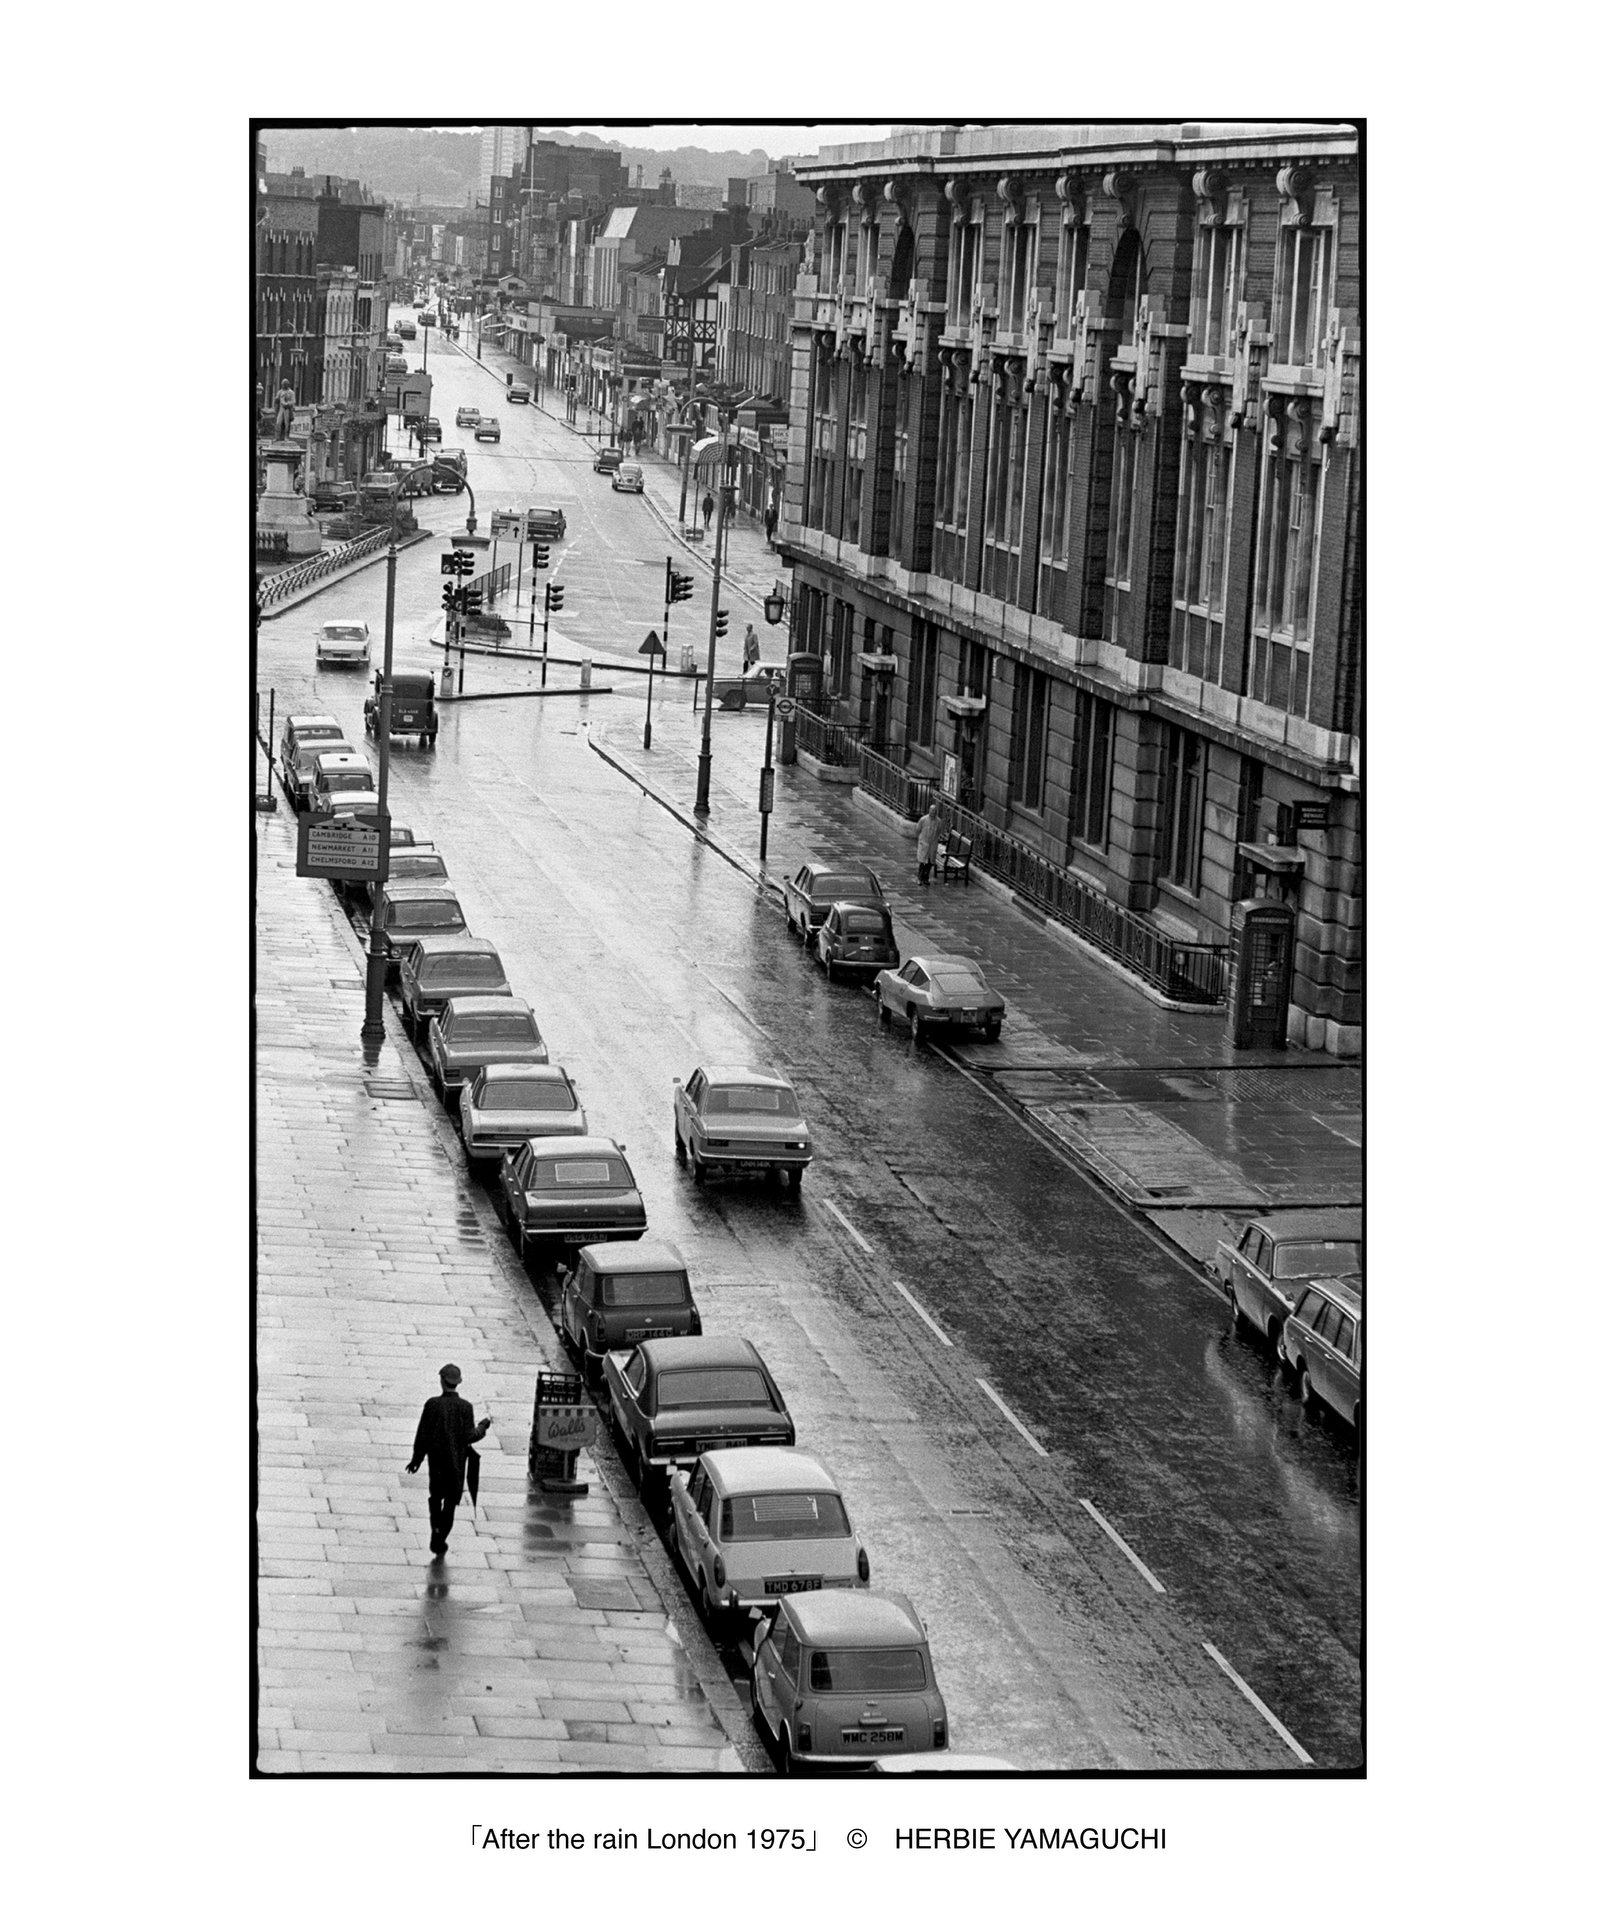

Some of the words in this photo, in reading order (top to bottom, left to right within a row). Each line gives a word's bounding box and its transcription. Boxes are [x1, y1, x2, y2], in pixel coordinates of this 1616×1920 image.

[311, 831, 352, 840] CAMBRIDGE
[362, 833, 376, 841] A10
[311, 844, 355, 853] NEWMARKET
[362, 845, 374, 854] A11
[311, 856, 357, 865] CHELMSFORD
[361, 858, 375, 867] A12
[548, 1417, 586, 1439] Wall's
[766, 1582, 789, 1592] TMD
[790, 1579, 821, 1591] 678F
[842, 1732, 868, 1743] WMC
[870, 1731, 904, 1743] 258M
